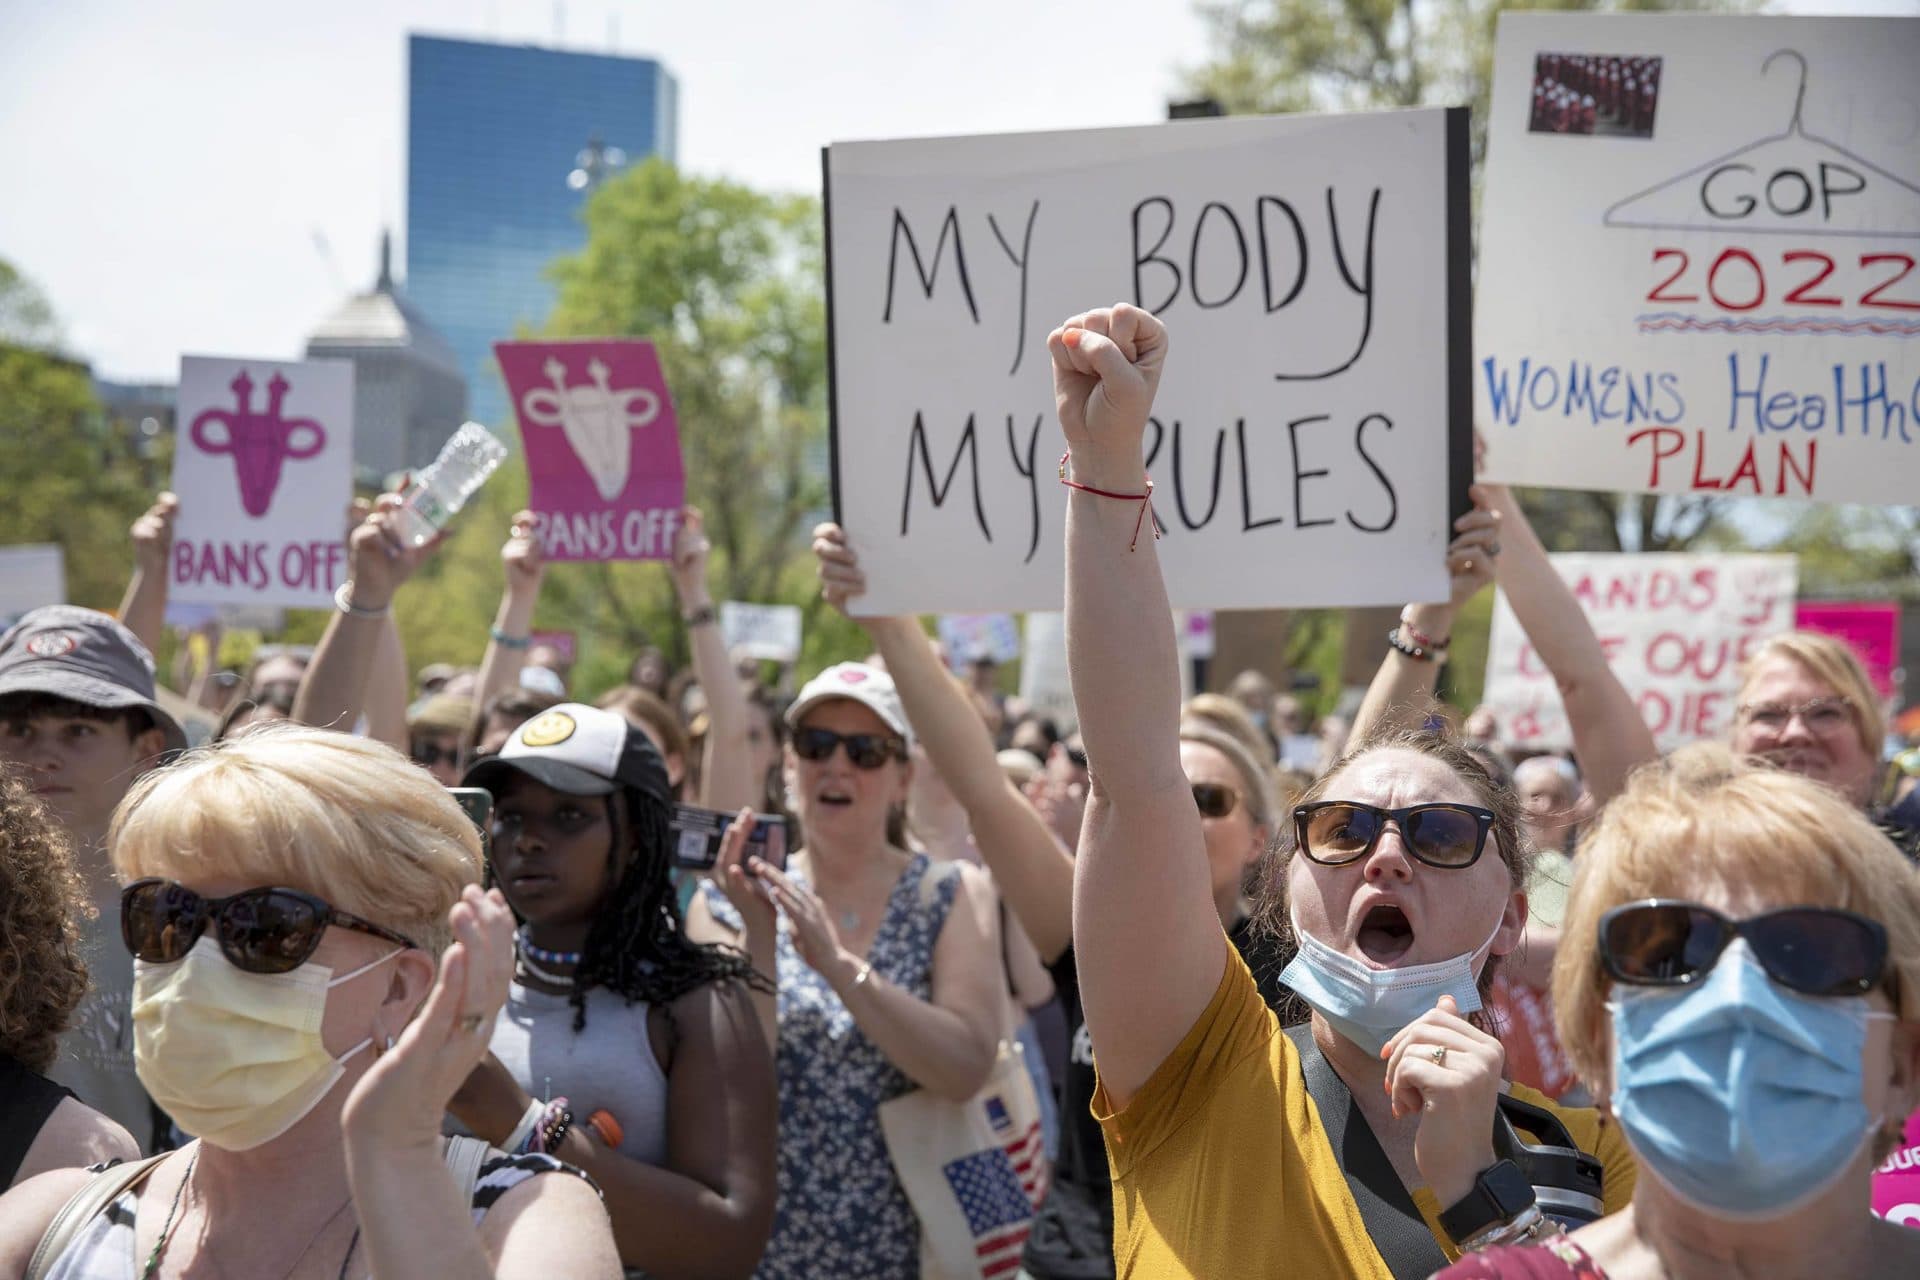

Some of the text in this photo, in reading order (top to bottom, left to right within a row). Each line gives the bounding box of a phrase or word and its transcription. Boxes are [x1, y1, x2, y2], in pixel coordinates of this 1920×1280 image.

[1700, 161, 1867, 221] GOP
[882, 186, 1382, 380] MY BODY
[1645, 247, 1920, 312] 2022
[1482, 350, 1920, 443] WOMENS Health
[901, 410, 1043, 563] MY
[1627, 427, 1818, 496] PLAN
[622, 508, 679, 555] OFF
[175, 539, 345, 592] BANS OFF
[1573, 568, 1718, 612] ANDS
